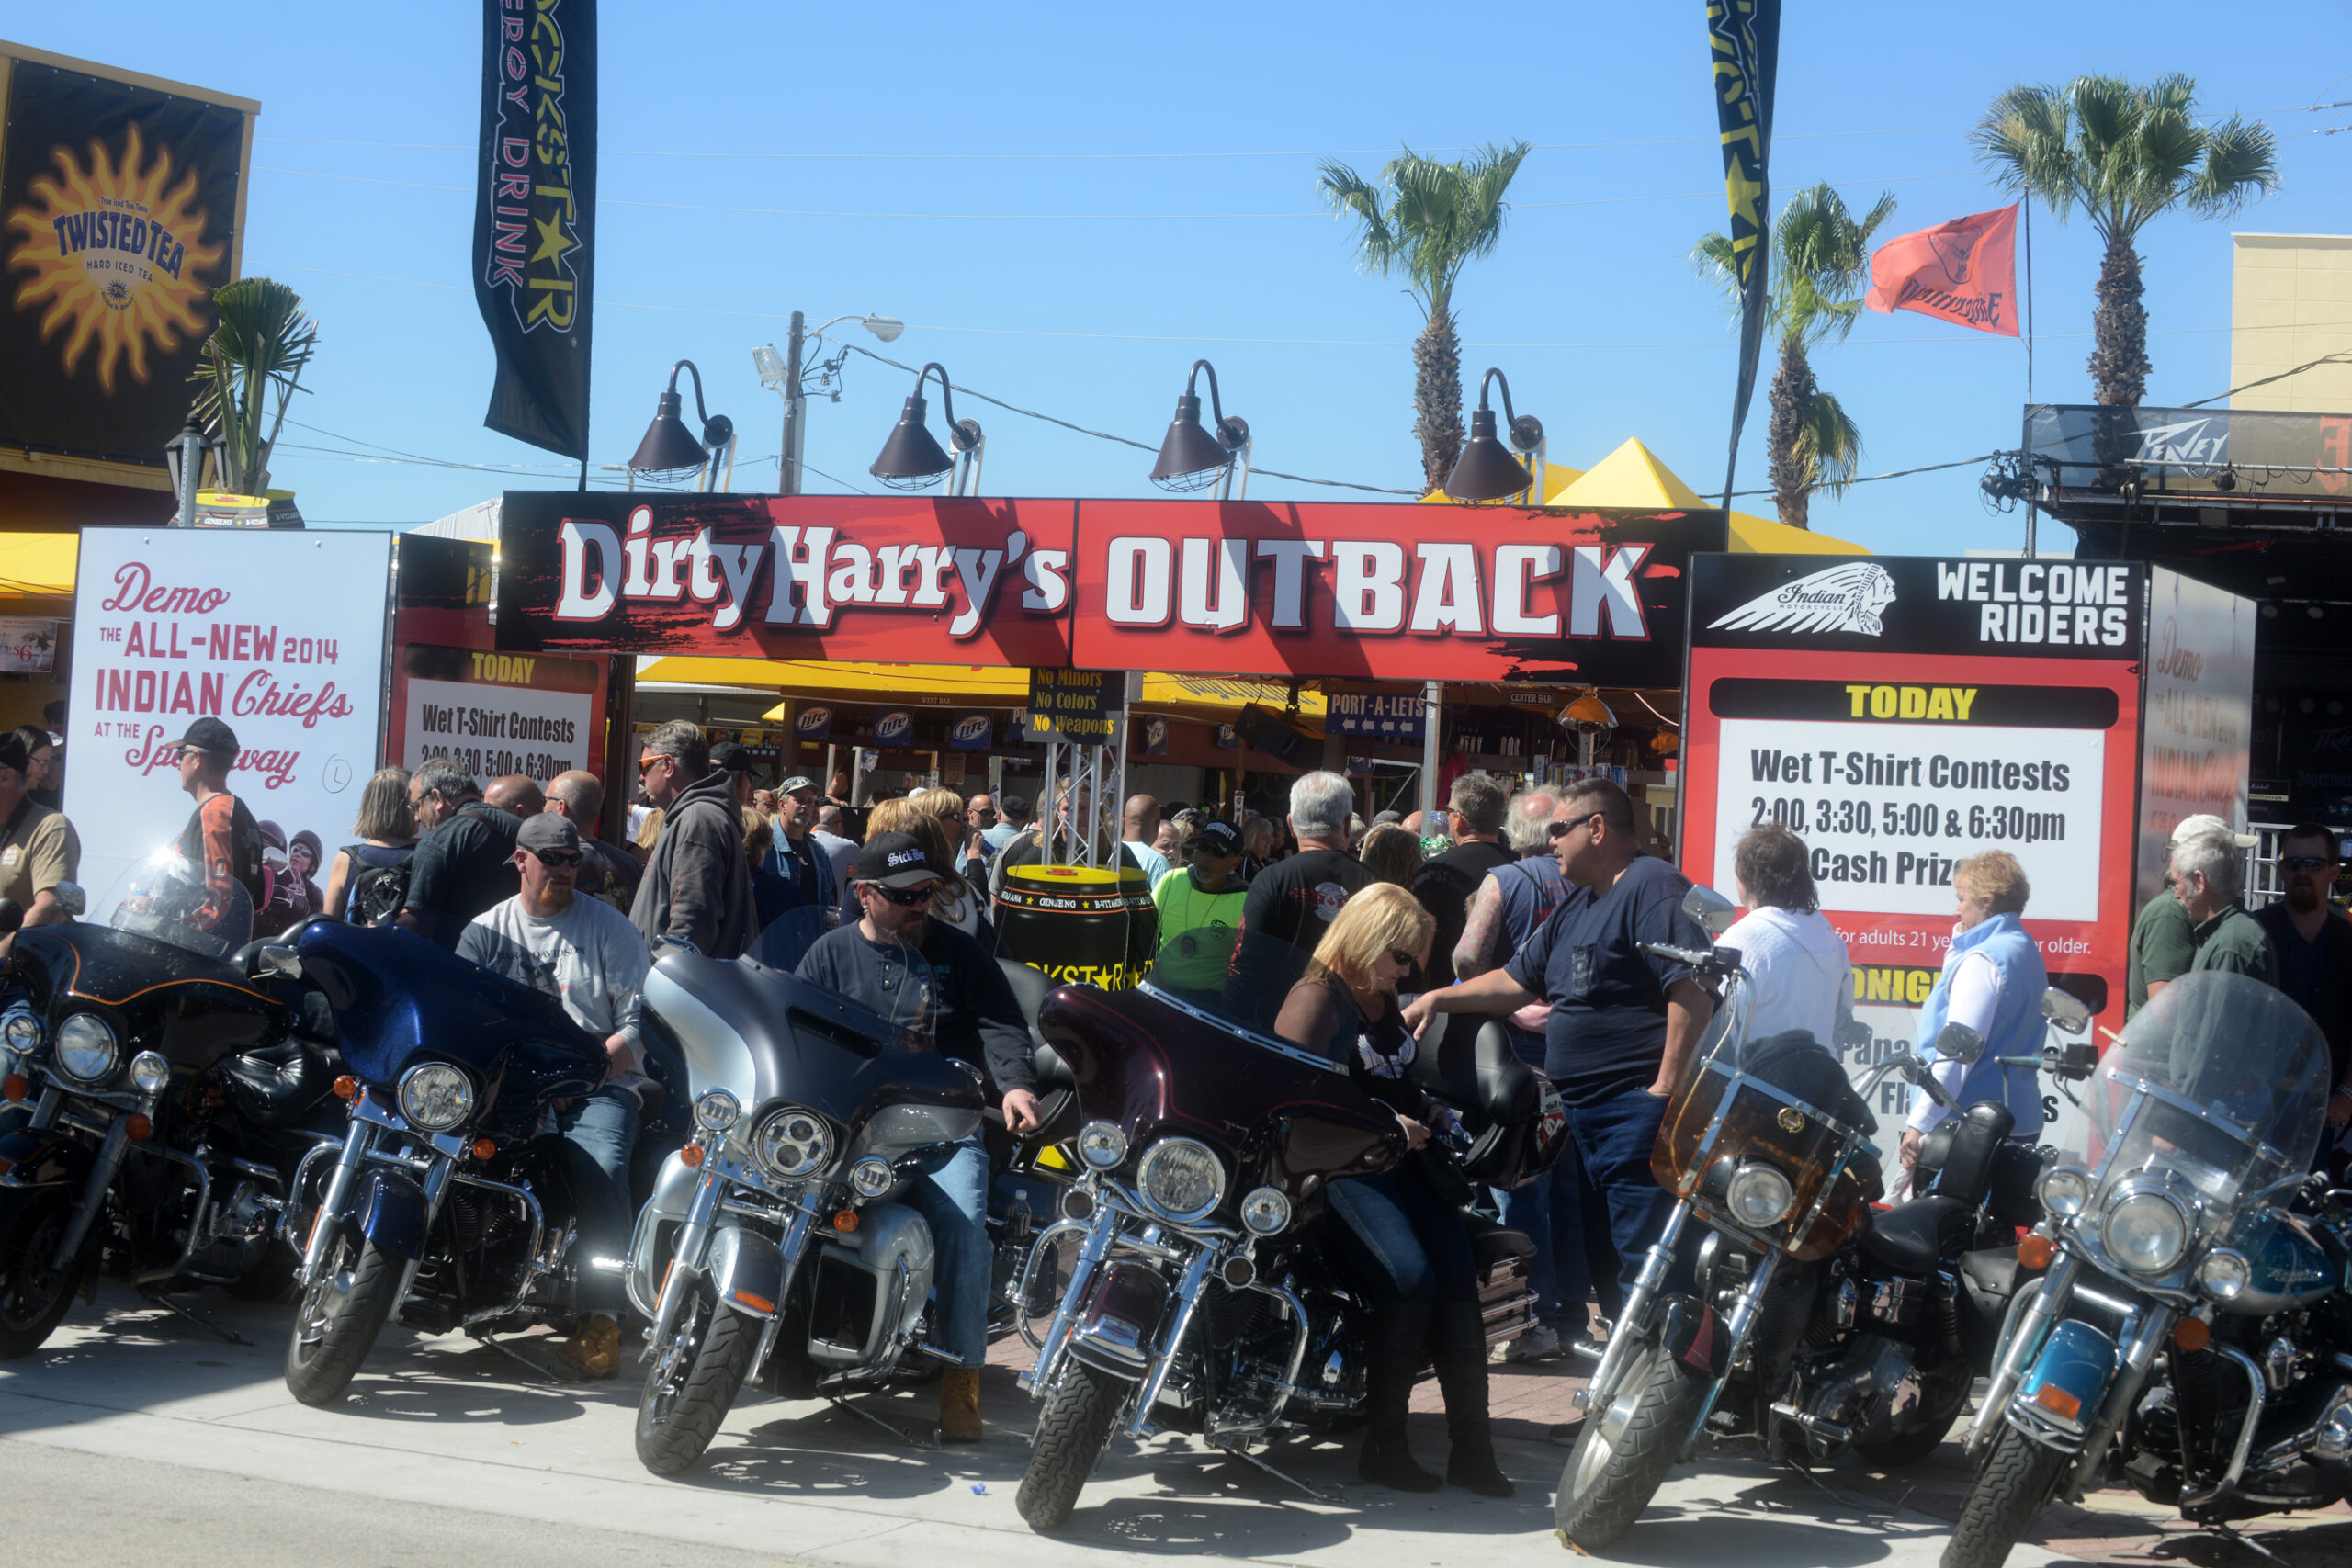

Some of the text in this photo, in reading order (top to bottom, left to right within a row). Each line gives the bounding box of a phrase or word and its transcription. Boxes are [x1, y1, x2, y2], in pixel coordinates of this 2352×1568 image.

[493, 137, 530, 288] DRINK
[52, 210, 185, 281] TWISTED TEA
[86, 259, 153, 283] HARD ICED TEA
[101, 561, 231, 615] Demo
[555, 504, 1654, 641] Dirty Harry's OUTBACK
[1777, 562, 2130, 605] Indian WELCOME
[99, 621, 339, 665] THE ALL-NEW 2014
[1979, 604, 2128, 646] RIDERS
[2156, 615, 2204, 682] Demo
[471, 652, 536, 684] TODAY
[1036, 668, 1102, 687] No Minors
[95, 668, 354, 729] INDIAN Chiefs
[922, 696, 938, 705] WEST
[1035, 691, 1097, 710] No Colors
[1510, 693, 1553, 704] CENTER BAR
[1846, 684, 1978, 721] TODAY
[94, 722, 111, 737] AT
[117, 723, 141, 739] THE
[423, 703, 576, 744] Wet T-Shirt Contests
[800, 710, 987, 739] Lite Lite Lite
[1033, 714, 1051, 732] No
[1056, 716, 1114, 737] Weapons
[485, 750, 513, 777] 5:00
[514, 755, 523, 775] &
[1750, 749, 2071, 792] Wet T-Shirt Contests
[2151, 744, 2200, 803] INDIAN
[1204, 821, 1237, 840] SECURITY
[1815, 798, 1876, 838] 3:30,
[1883, 801, 1939, 838] 5:00
[1944, 808, 1962, 838] &
[1968, 804, 2066, 844] 6:30pm
[1810, 847, 1960, 886] Cash Priz
[1038, 897, 1077, 909] GINSENG
[1834, 927, 1856, 943] for
[1859, 929, 1906, 946] adults
[1909, 931, 1927, 947] 21
[2048, 936, 2092, 954] older.
